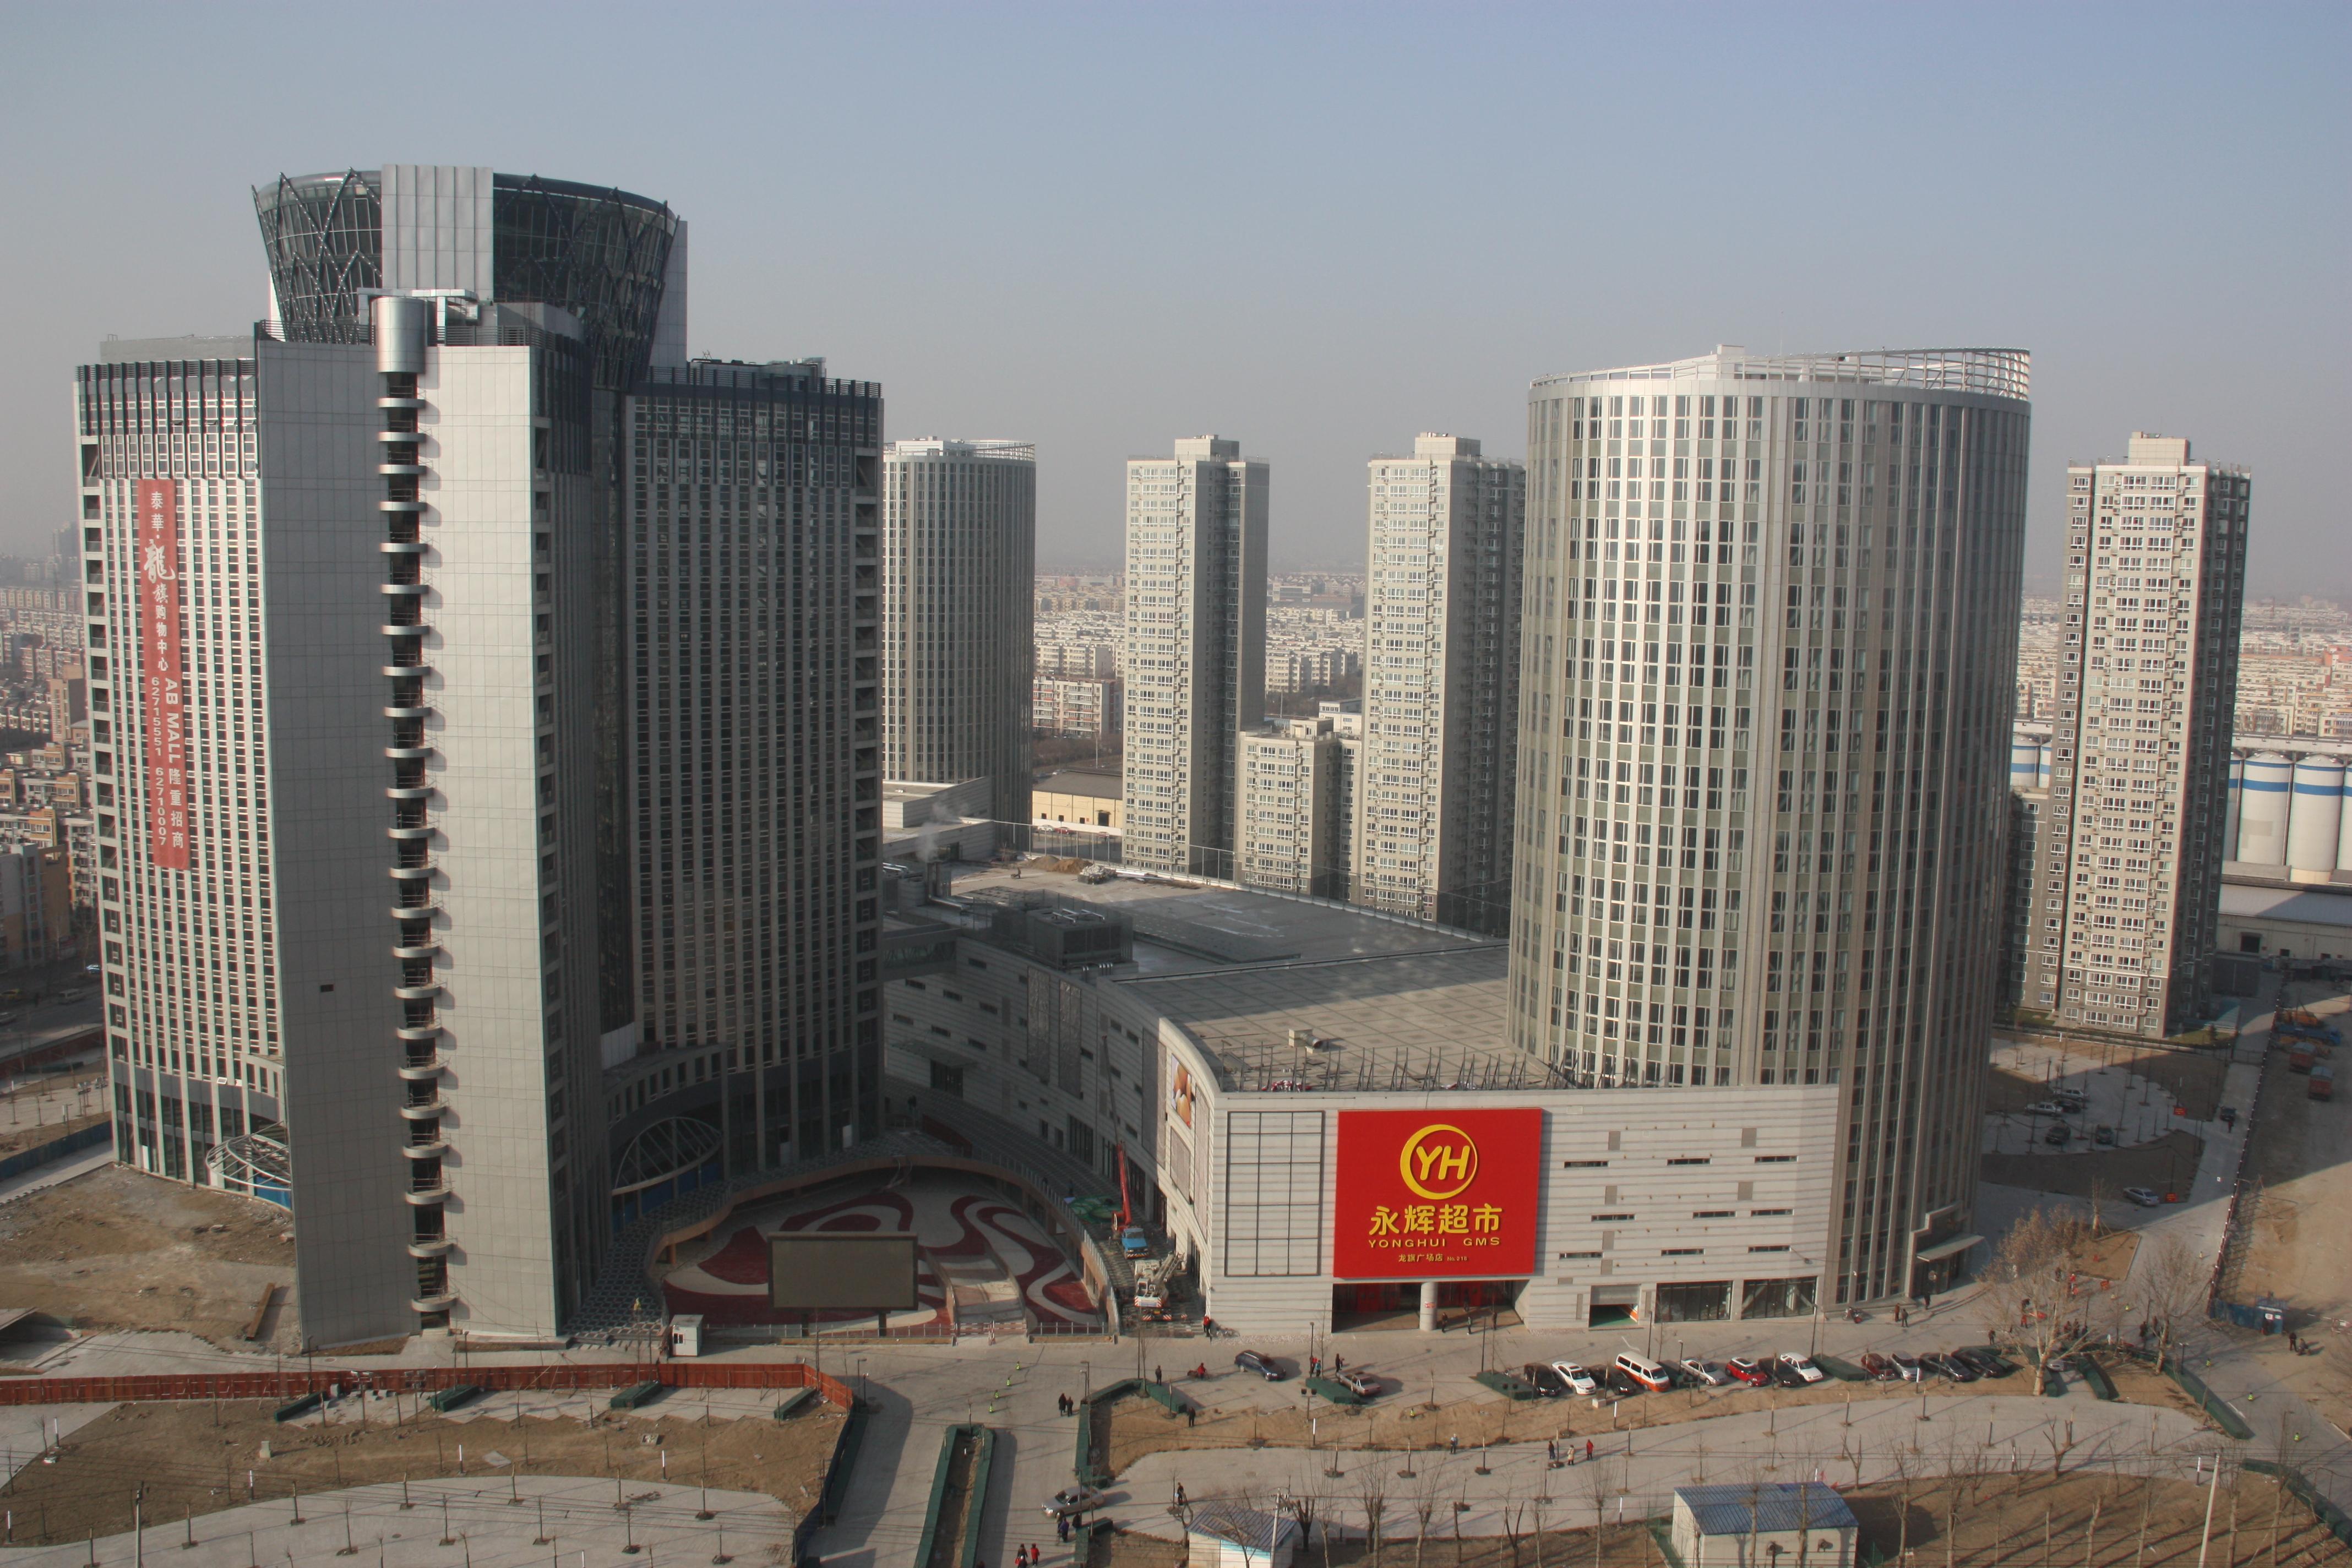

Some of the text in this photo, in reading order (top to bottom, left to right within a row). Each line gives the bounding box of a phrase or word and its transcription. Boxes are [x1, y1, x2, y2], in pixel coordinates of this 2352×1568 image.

[151, 677, 166, 846] 62715551 62710007
[165, 677, 184, 848] AB MALL 隆重招商
[1416, 1145, 1471, 1181] YH
[1369, 1203, 1502, 1235] 永辉超市
[1369, 1237, 1500, 1248] YONGHUI GMS
[1398, 1253, 1444, 1262] 龙旗广场店
